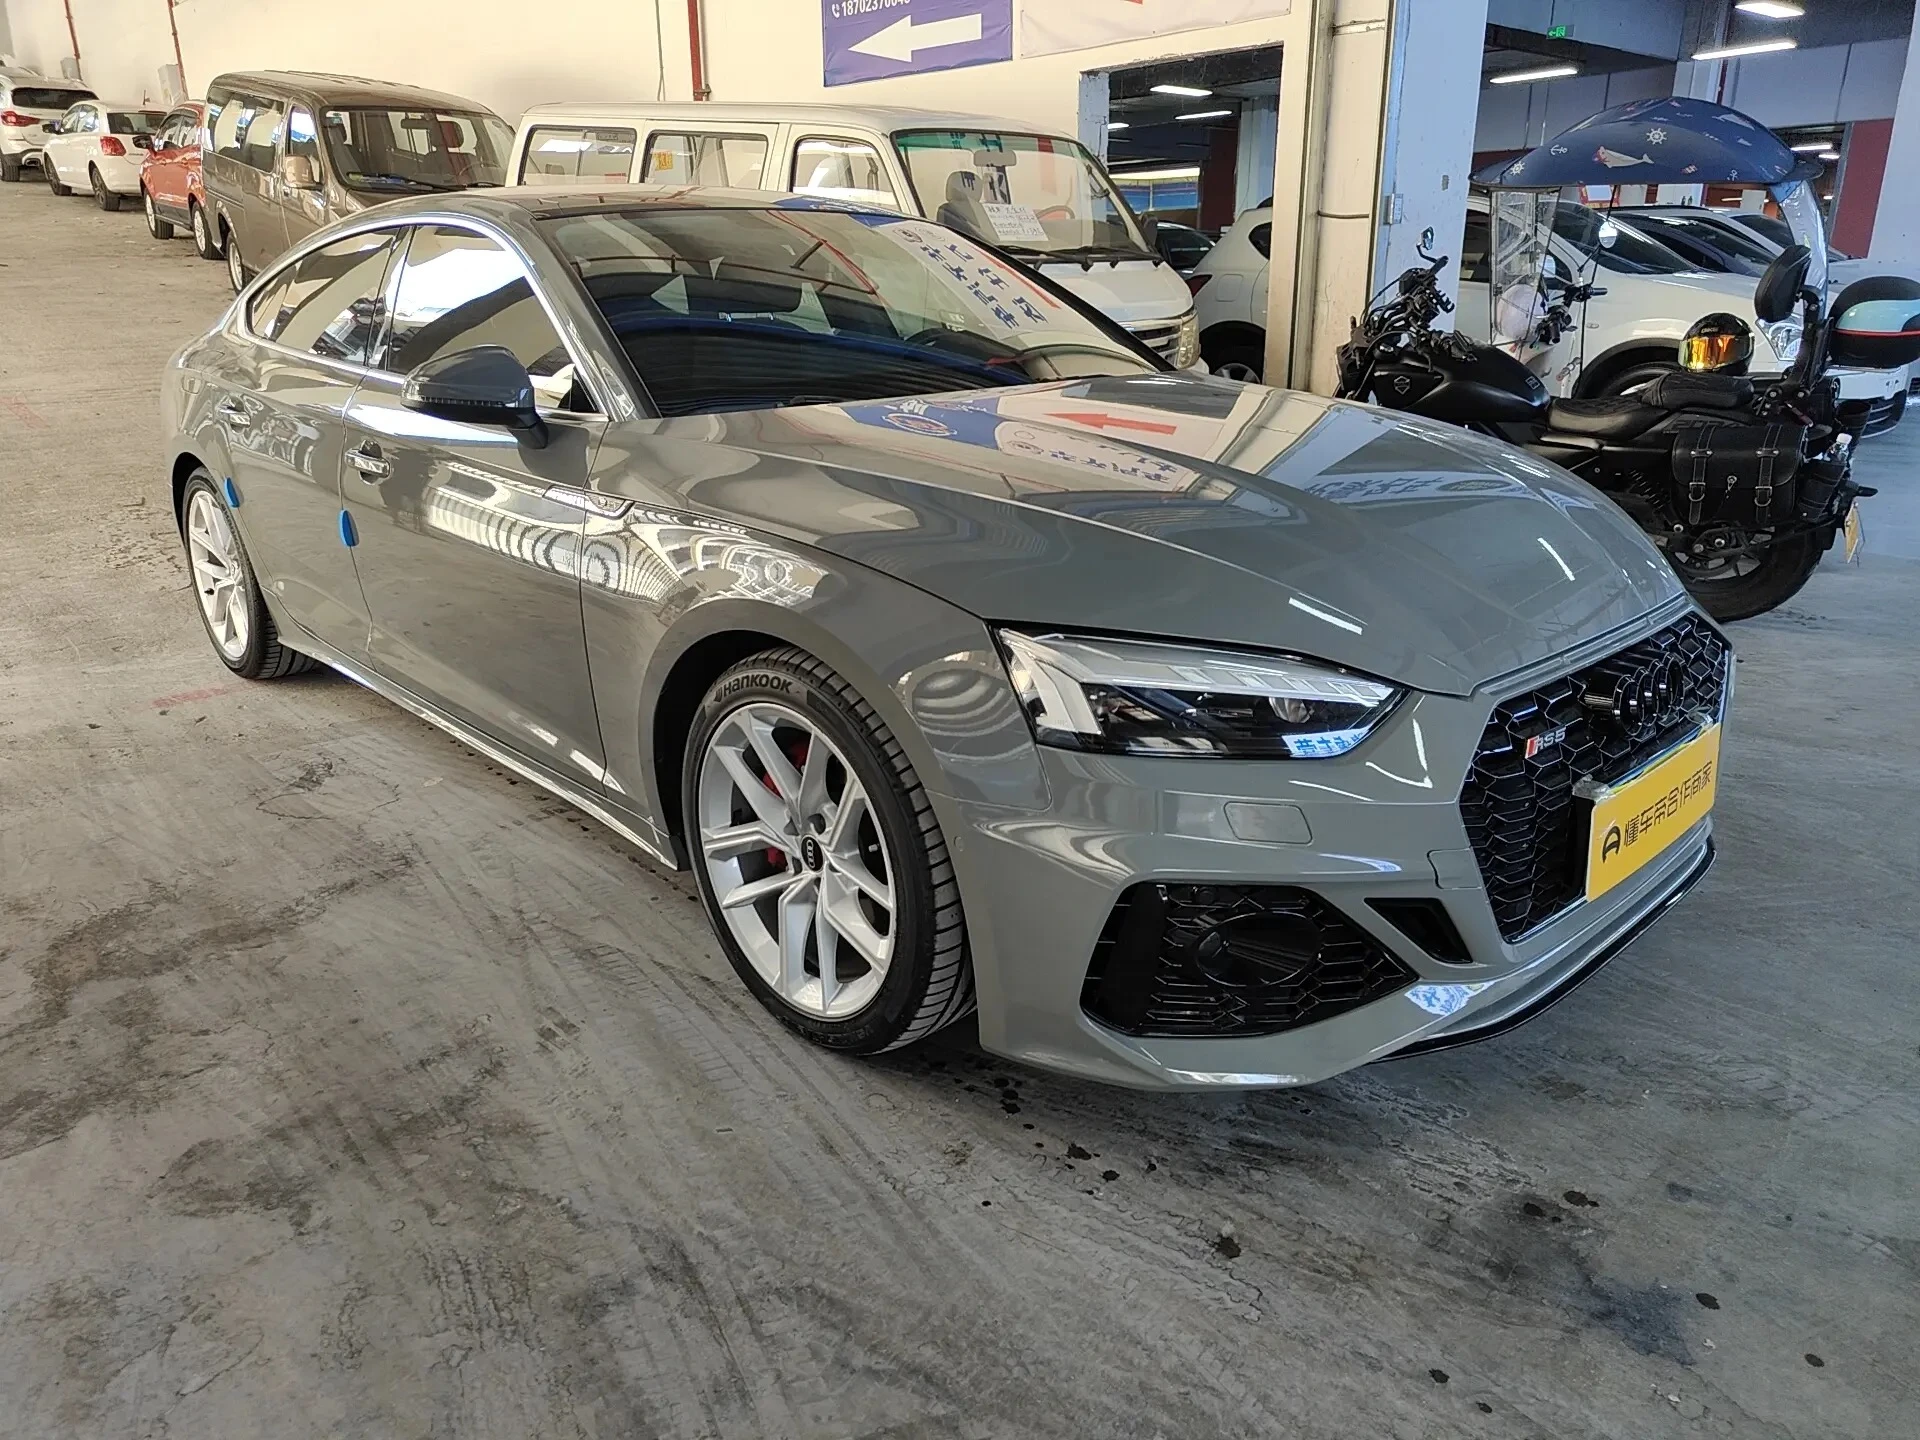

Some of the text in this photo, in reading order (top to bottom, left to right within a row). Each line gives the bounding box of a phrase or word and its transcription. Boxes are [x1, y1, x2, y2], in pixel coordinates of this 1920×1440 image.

[841, 0, 911, 16] 18702370
[1535, 726, 1567, 750] RS5
[1624, 760, 1713, 847] 懂车帝合作商家
